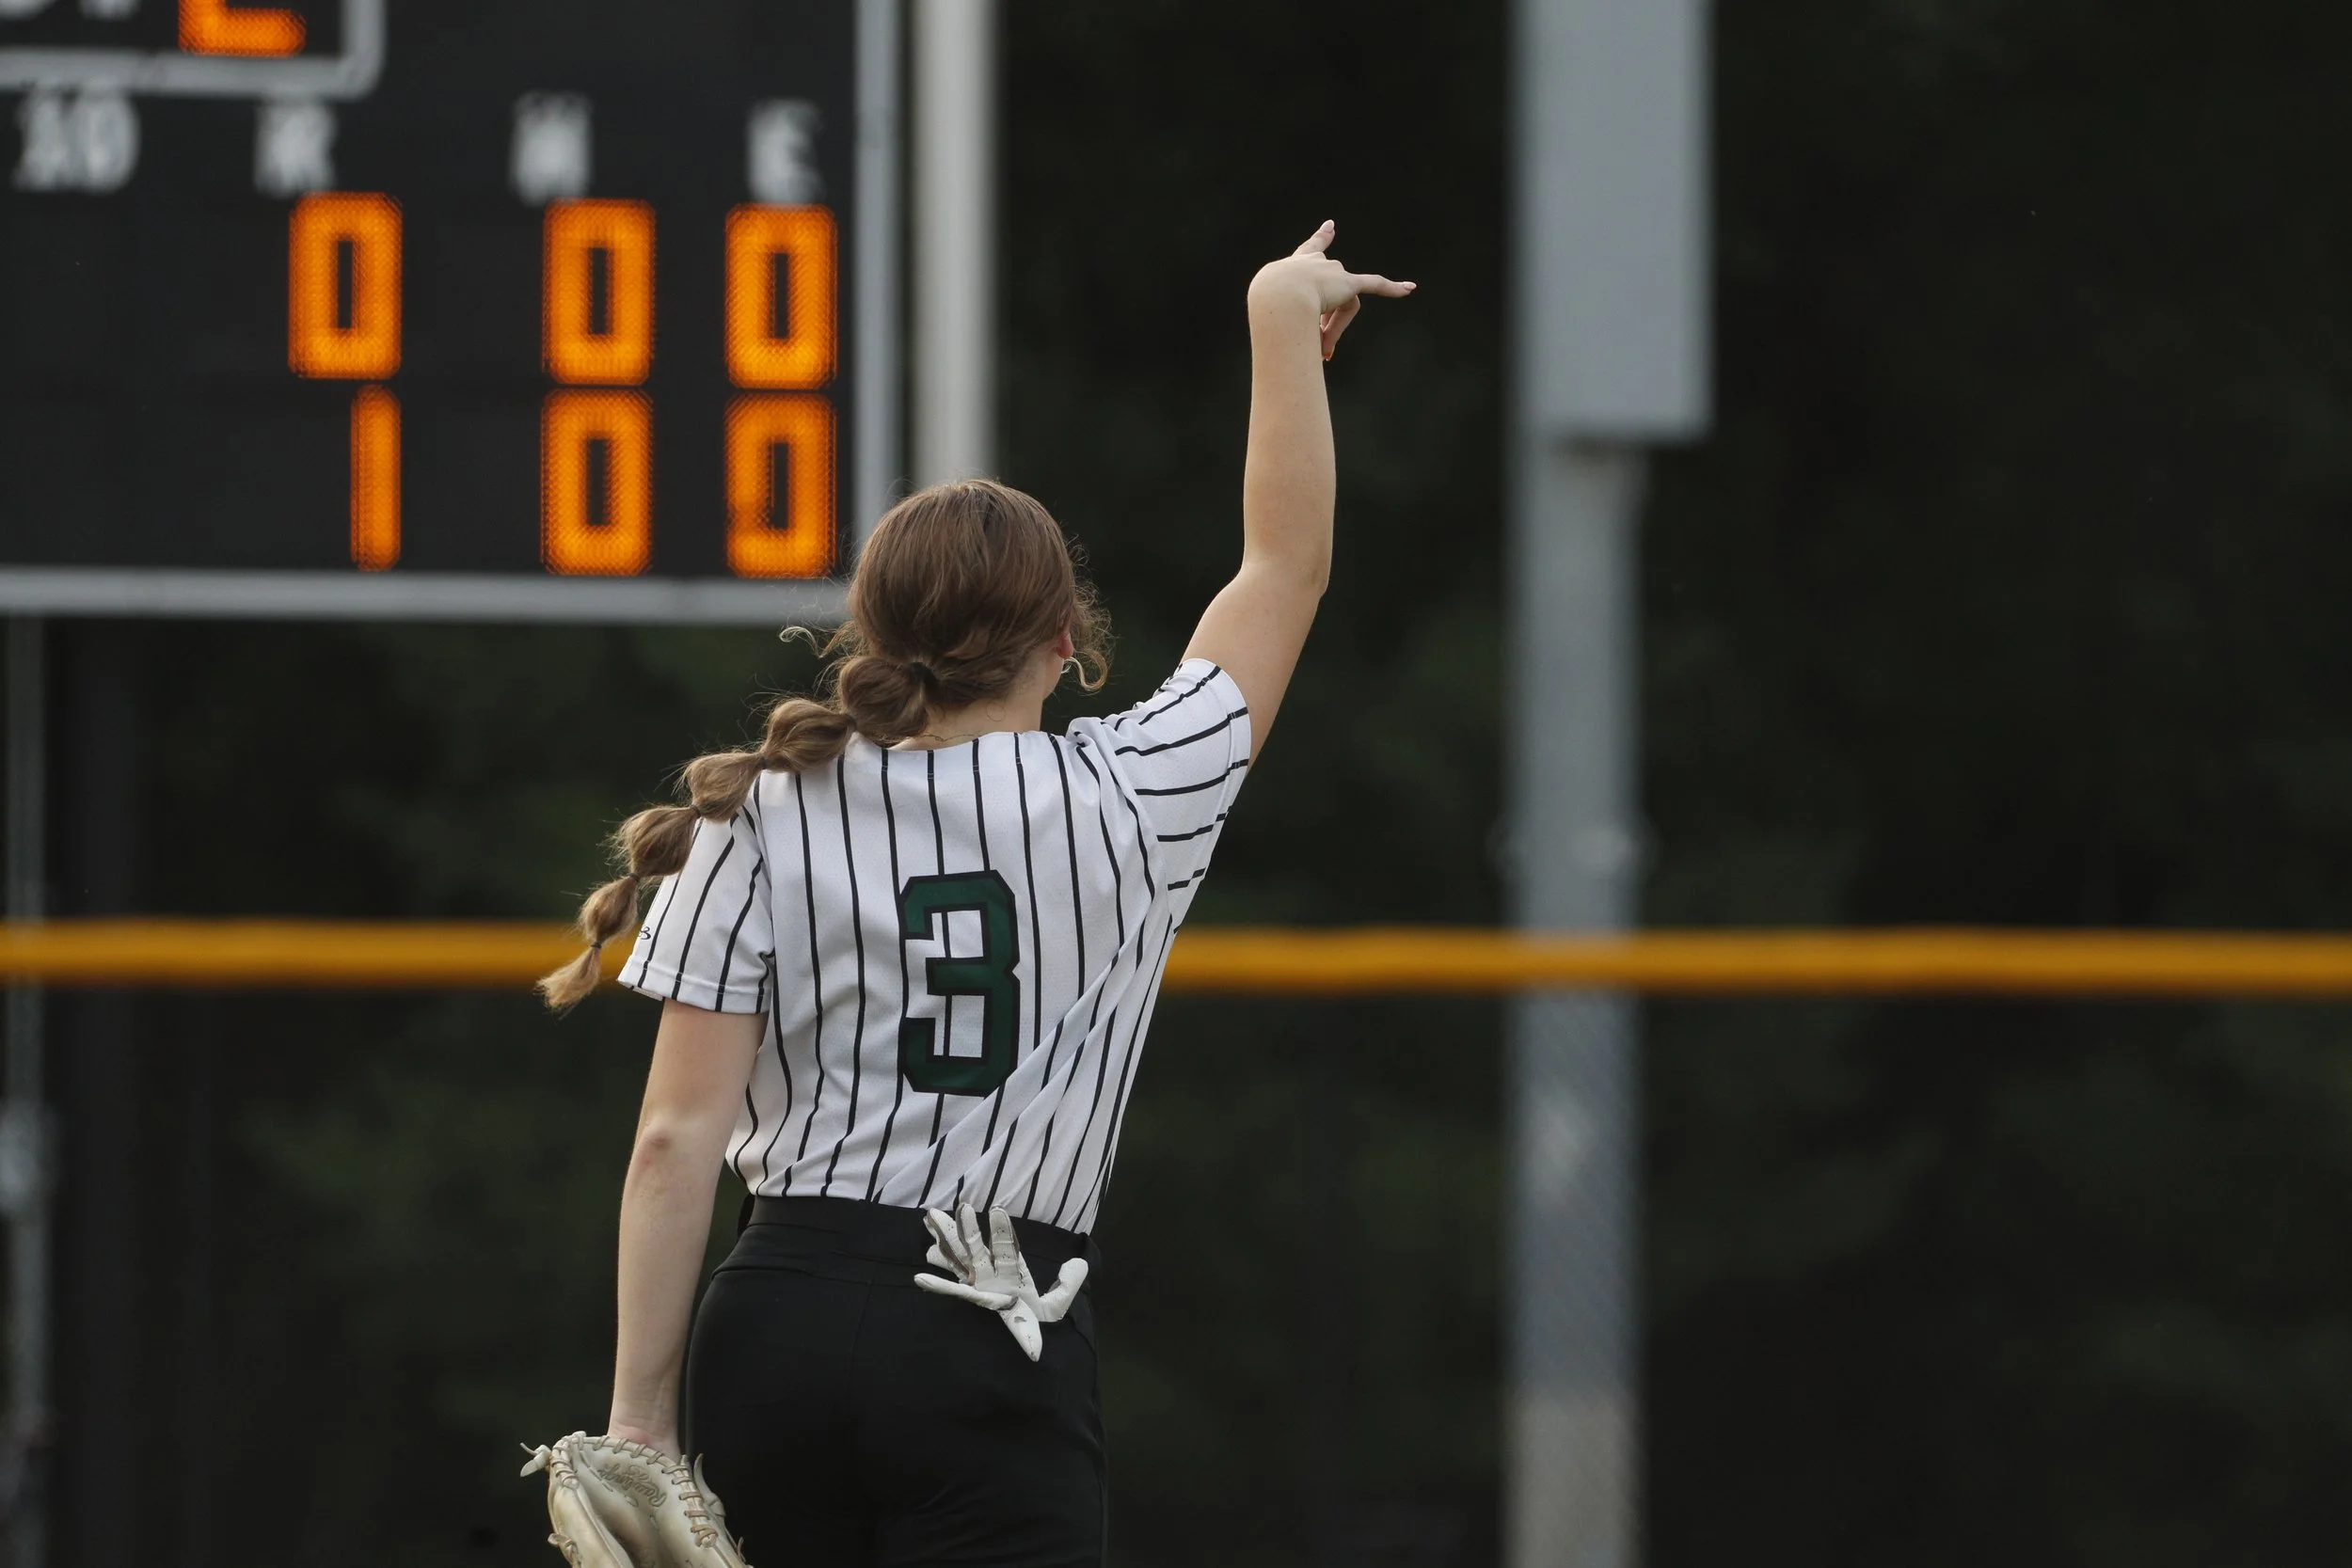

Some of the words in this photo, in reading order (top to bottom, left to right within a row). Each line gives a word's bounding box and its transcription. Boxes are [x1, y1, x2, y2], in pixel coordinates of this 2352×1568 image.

[289, 192, 403, 380] 0
[543, 198, 656, 387] 0
[725, 203, 837, 389] 0
[351, 386, 401, 570] 1
[541, 388, 654, 576] 0
[725, 391, 838, 578] 0
[898, 869, 1021, 1097] 3
